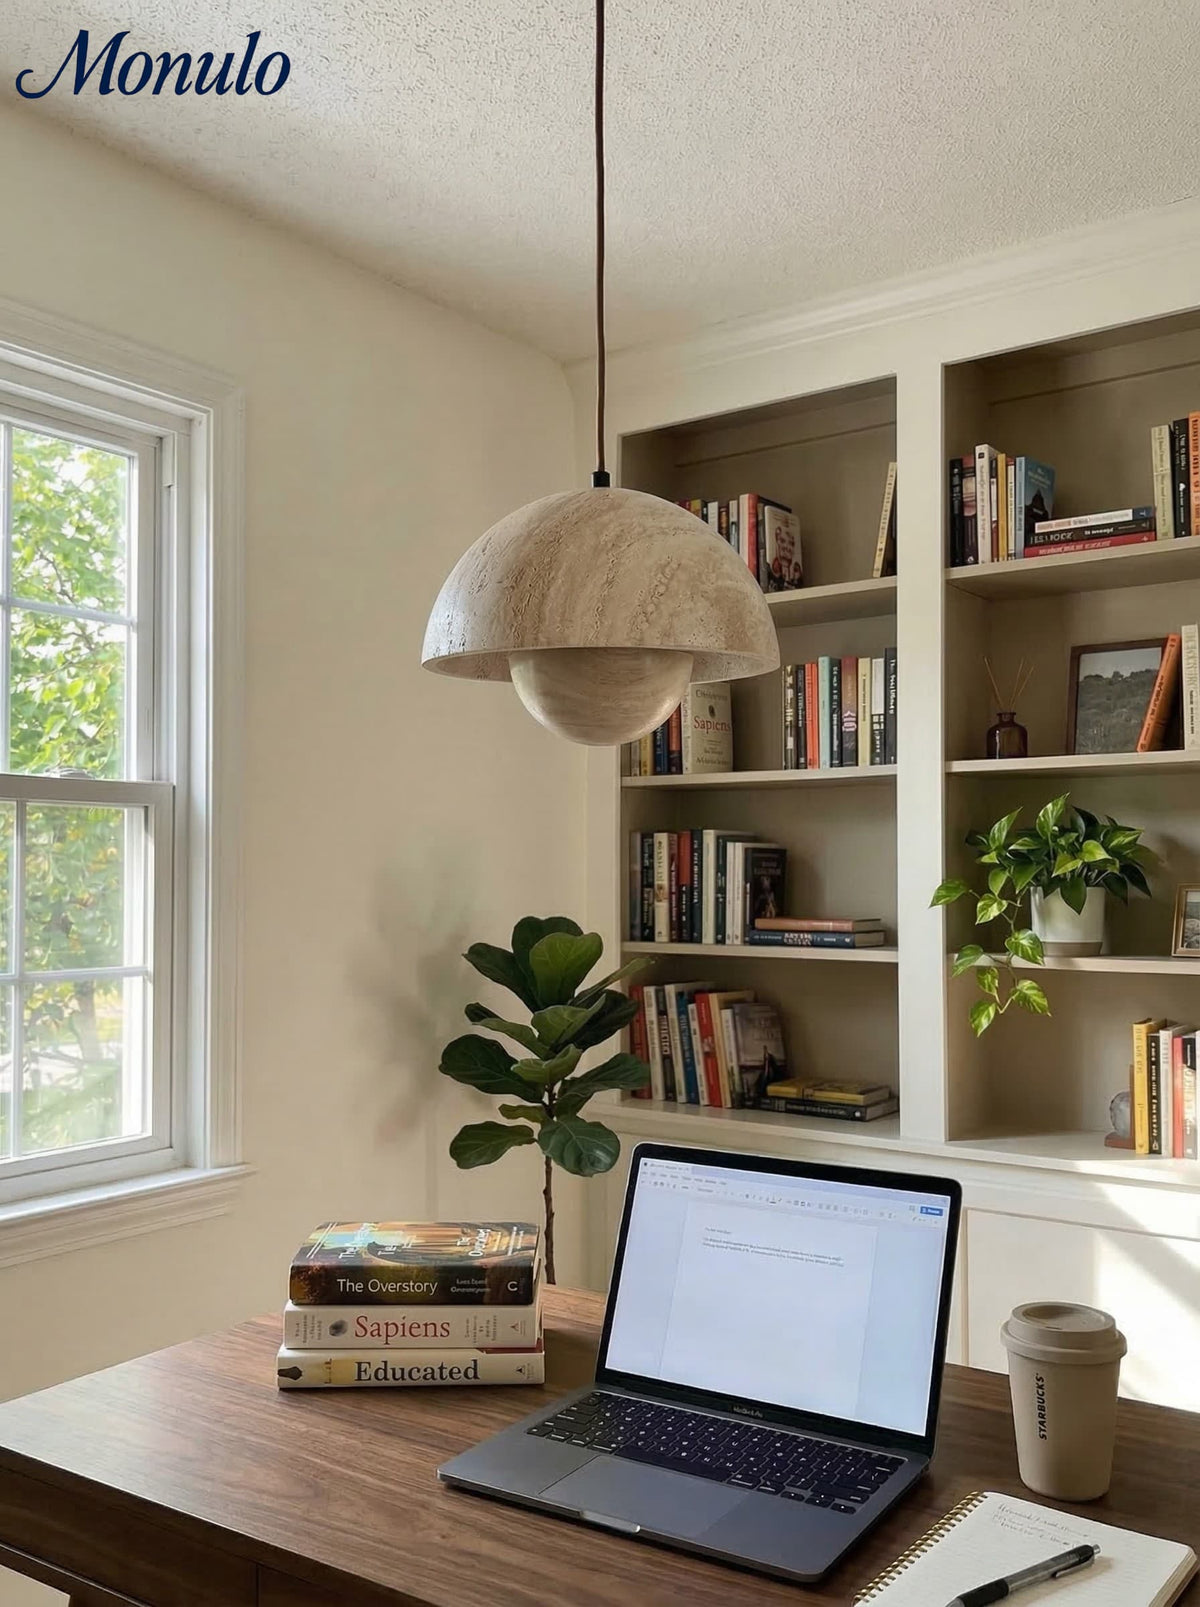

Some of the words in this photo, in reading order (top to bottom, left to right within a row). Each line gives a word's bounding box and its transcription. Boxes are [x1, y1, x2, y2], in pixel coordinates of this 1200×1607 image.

[336, 1278, 364, 1293] The
[367, 1278, 438, 1296] Overstory
[354, 1315, 450, 1345] Sapiens
[354, 1359, 480, 1382] Educated
[1035, 1372, 1048, 1441] STARBUCKS
